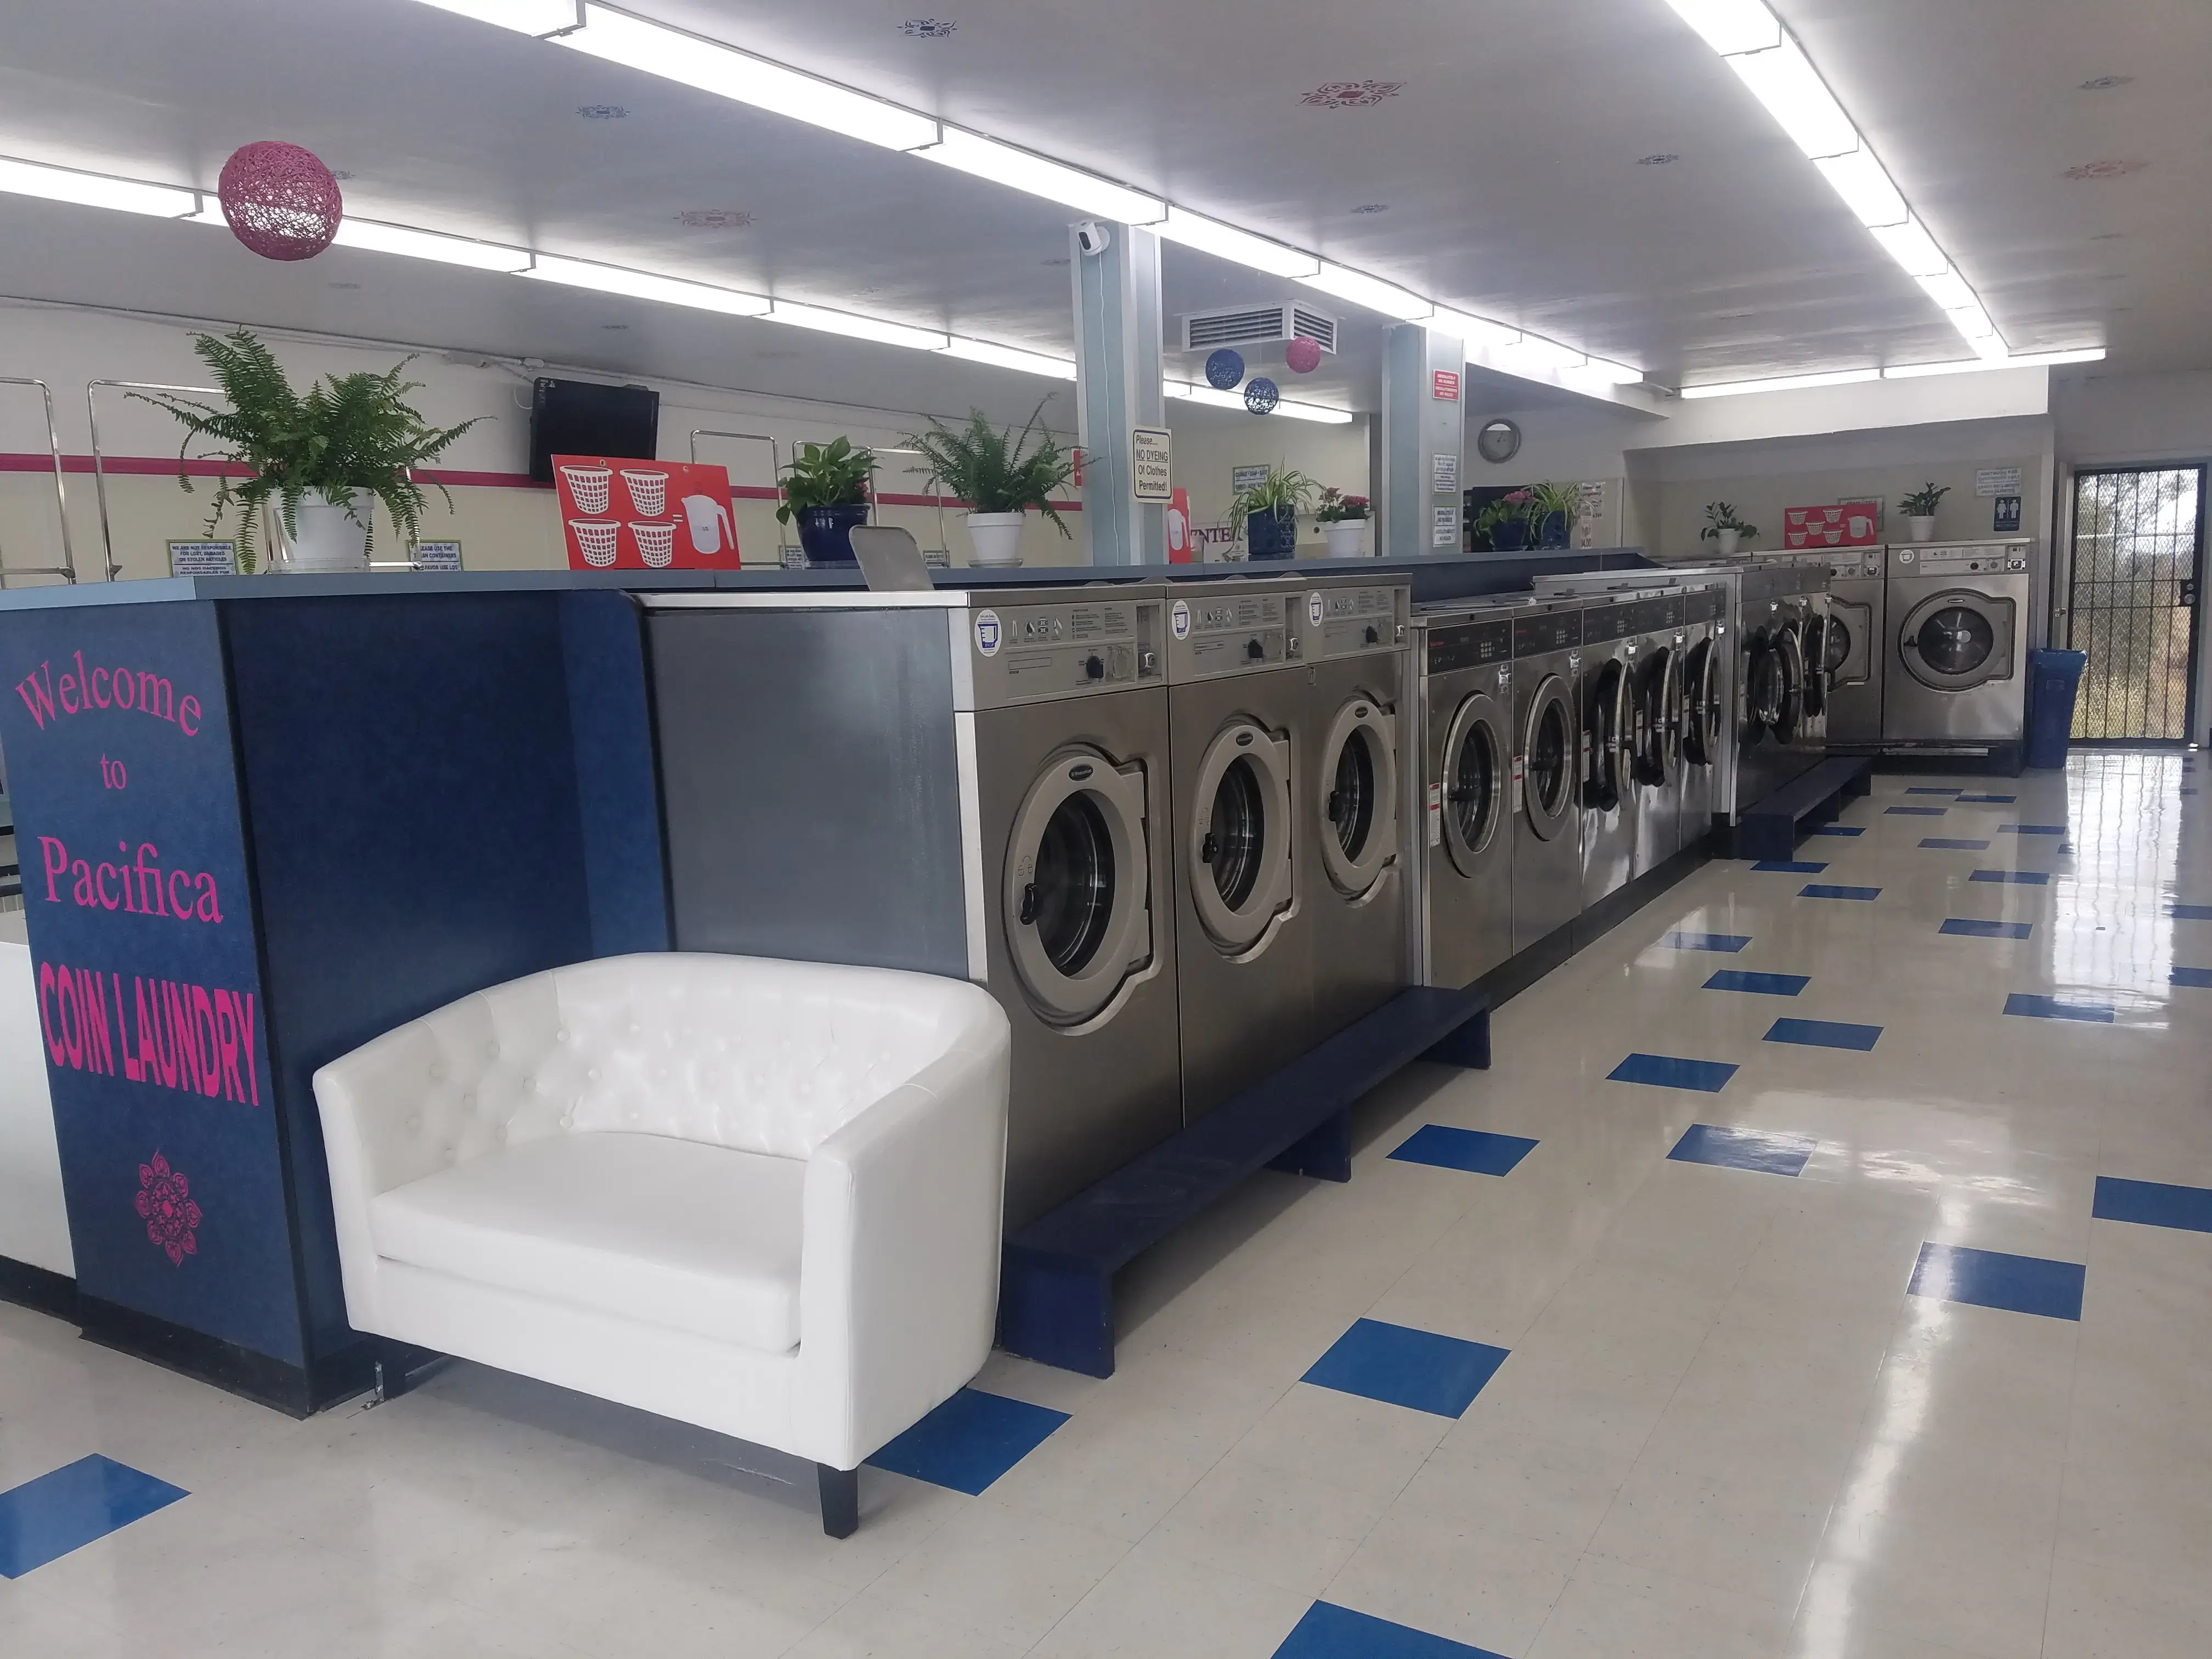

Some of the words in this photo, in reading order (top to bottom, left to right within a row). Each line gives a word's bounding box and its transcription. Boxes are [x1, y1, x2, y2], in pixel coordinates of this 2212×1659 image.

[1136, 449, 1145, 460] NO
[1147, 449, 1168, 461] DYEING
[1138, 464, 1145, 475] Of
[1147, 465, 1167, 476] Clothes
[1139, 479, 1167, 492] Permitted!
[1190, 527, 1244, 544] NTE
[15, 650, 201, 736] Welcome
[100, 753, 127, 789] to
[37, 836, 224, 923] Pacifica
[40, 962, 114, 1076] COIN
[113, 973, 259, 1107] LAUNDRY
